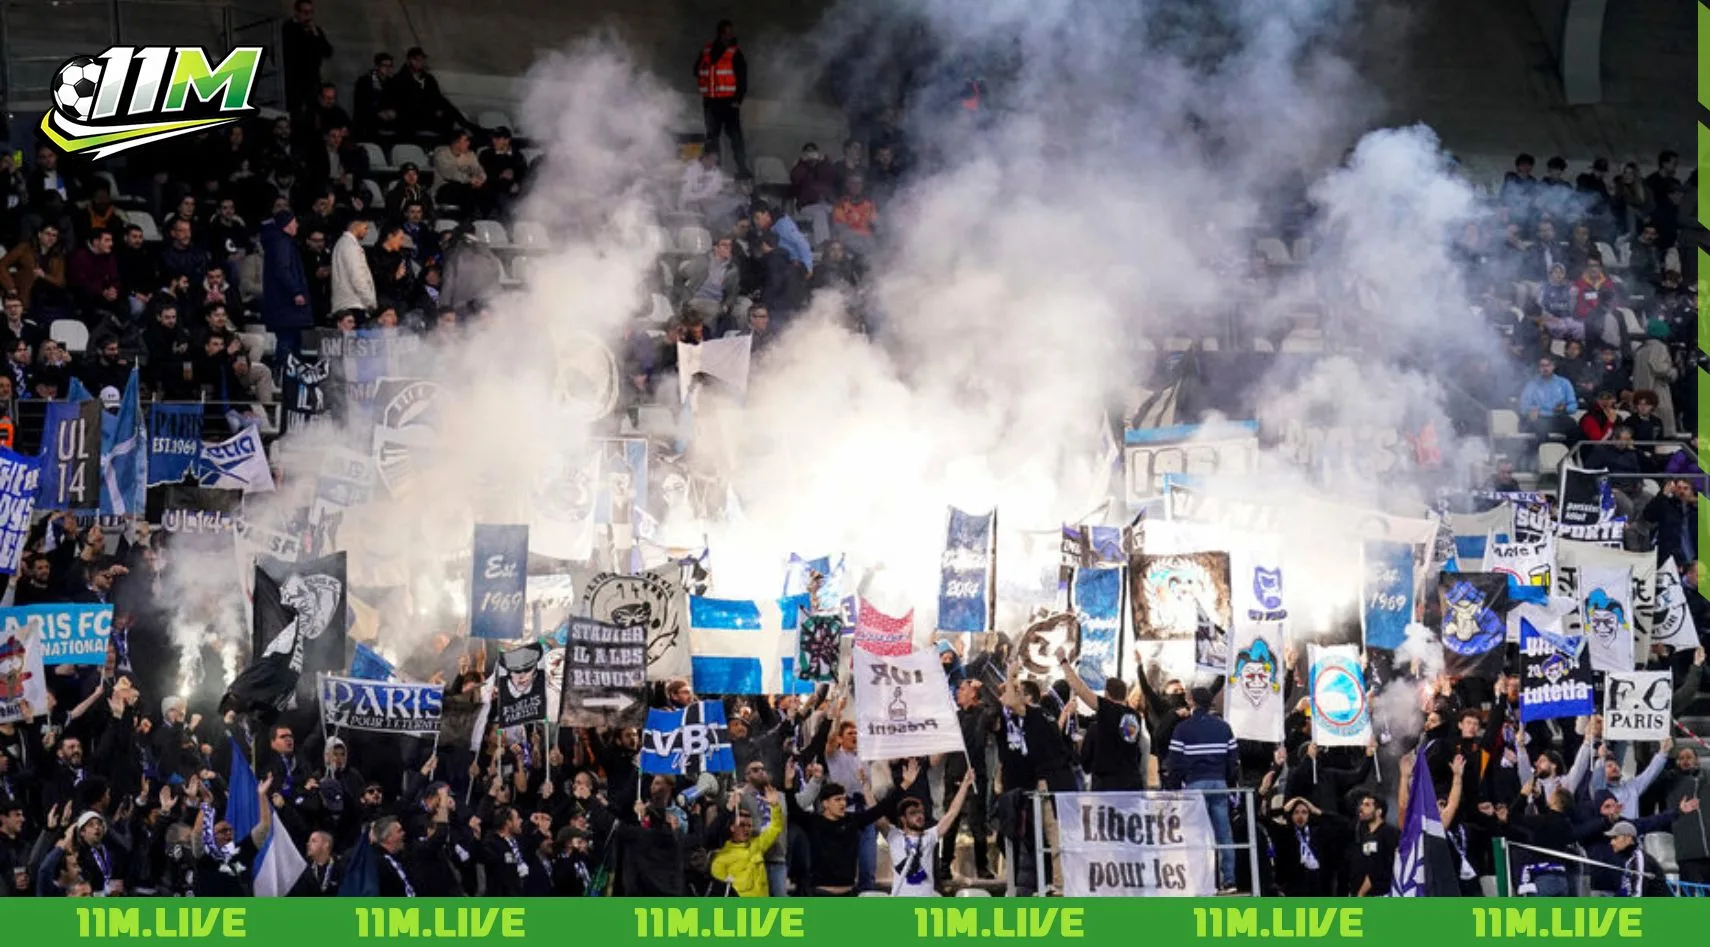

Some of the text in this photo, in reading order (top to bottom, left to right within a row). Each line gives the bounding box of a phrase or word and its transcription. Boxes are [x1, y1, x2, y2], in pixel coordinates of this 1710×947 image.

[58, 418, 89, 461] UL
[58, 462, 85, 503] 14
[484, 555, 517, 579] Est
[480, 590, 523, 614] 1969
[78, 610, 113, 638] FC
[324, 680, 442, 725] PARIS
[1610, 712, 1664, 730] PARIS
[1082, 804, 1184, 846] Liberté
[1089, 859, 1186, 893] pour les
